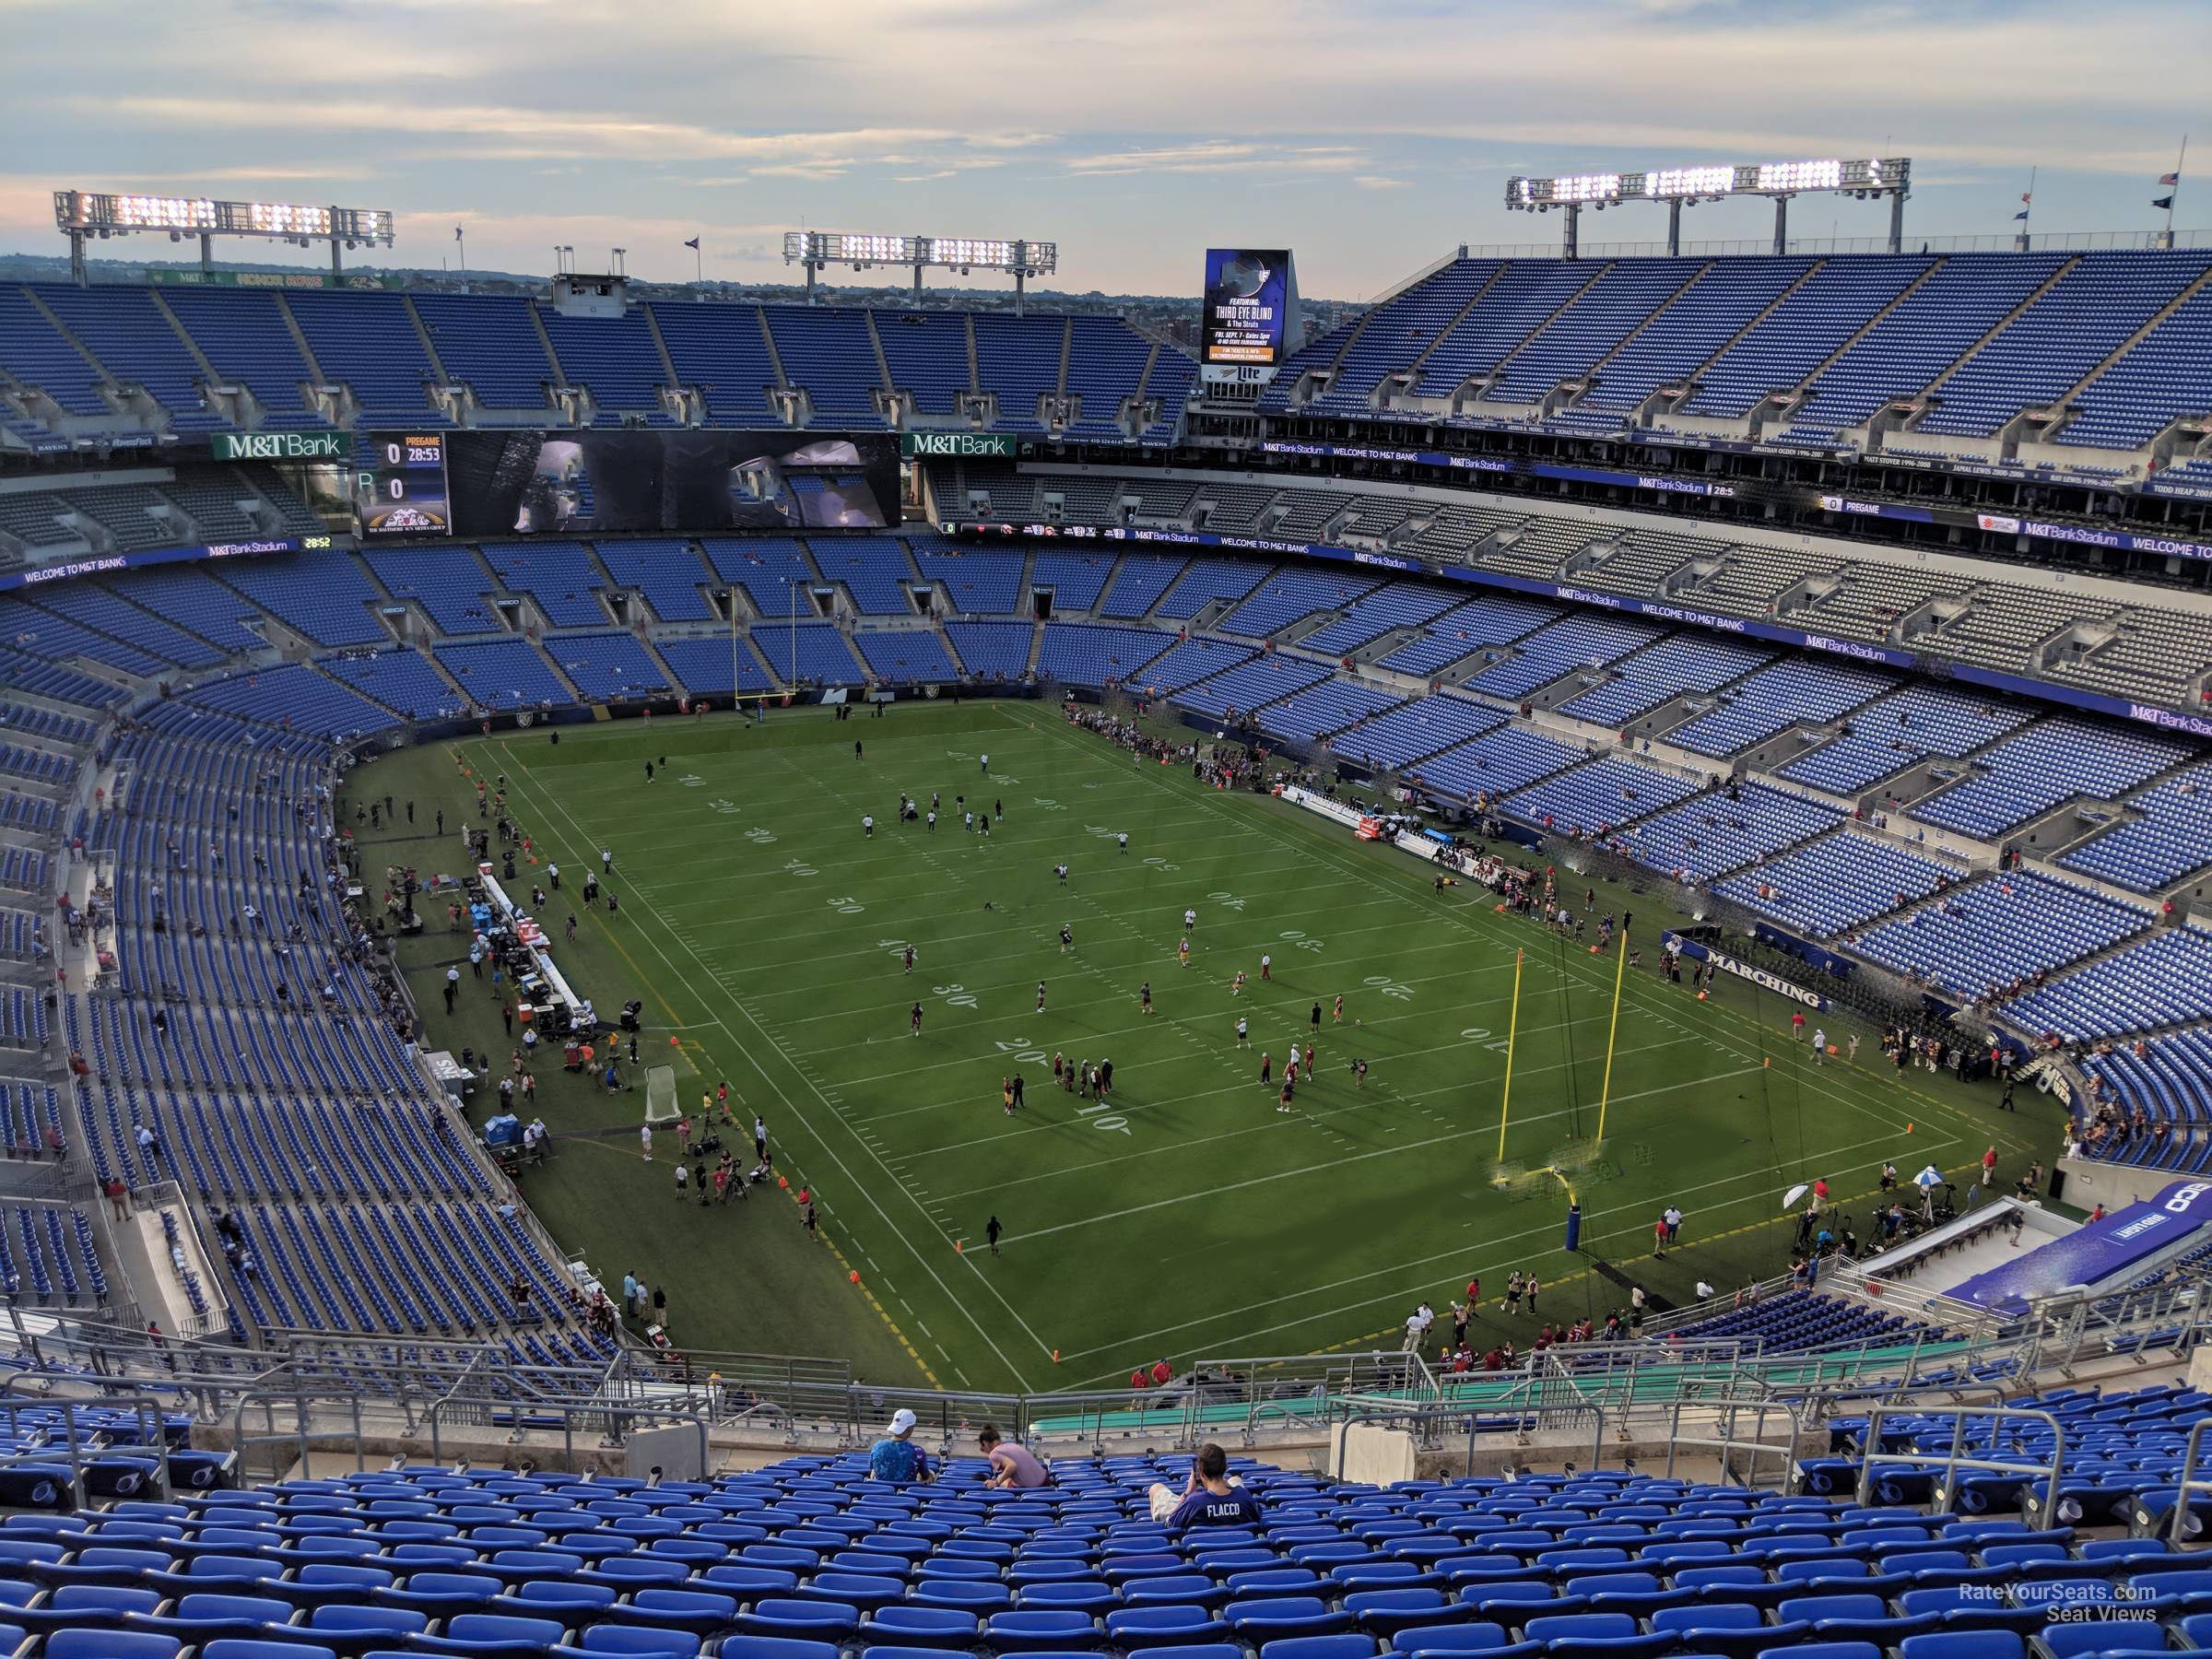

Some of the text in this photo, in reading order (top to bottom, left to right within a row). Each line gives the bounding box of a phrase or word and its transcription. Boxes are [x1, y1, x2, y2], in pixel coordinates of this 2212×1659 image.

[286, 276, 323, 287] ROWS
[1230, 298, 1260, 306] FEATURING:
[1217, 306, 1272, 320] THIRD EYE BLIND
[1242, 320, 1259, 328] Struts
[37, 443, 68, 452] RAVENS
[227, 433, 341, 458] M&T Bank
[406, 437, 441, 446] PREGAME
[912, 434, 1006, 455] M&T Bank
[1264, 443, 1324, 454] M&T Bank Stadium
[387, 443, 400, 465] 0
[408, 448, 441, 462] 28:53
[1333, 447, 1368, 457] WELCOME
[1369, 450, 1379, 458] TO
[1380, 452, 1395, 460] M&T
[1751, 445, 1777, 454] JONATHAN
[1797, 449, 1824, 458] 1996-2007
[1450, 456, 1505, 471] M&T Bank Stadium
[1878, 457, 1900, 465] STOVER
[1952, 464, 1972, 473] JAMAL
[1972, 466, 1992, 475] LEWIS
[1638, 477, 1703, 493] M&T Bank Stadium
[2064, 476, 2082, 484] LEWIS
[391, 478, 404, 499] 0
[2153, 485, 2173, 493] TODD
[2174, 487, 2194, 496] HEAP
[1846, 501, 1879, 514] PREGAME
[1135, 530, 1199, 544] M&T Bank Stadium
[2025, 522, 2053, 536] M&T
[2051, 525, 2077, 540] Bank
[2076, 529, 2118, 546] Stadium
[208, 542, 288, 557] M&T Bank Stadium
[305, 537, 331, 548] 28:52
[1221, 536, 1257, 548] WELCOME
[1259, 540, 1269, 549] TO
[1270, 542, 1287, 551] M&T
[2132, 537, 2194, 557] WELCOME
[1354, 552, 1406, 570] M&T Bank Stadium
[25, 567, 66, 582] WELCOME
[66, 565, 78, 575] TO
[78, 561, 97, 574] M&T
[1557, 587, 1620, 608] M&T Bank Stadium
[1641, 603, 1682, 618] WELCOME
[1685, 611, 1697, 621] TO
[1698, 612, 1716, 625] M&T
[1806, 634, 1886, 662] M&T Bank Stadium
[2129, 704, 2161, 723] M&T
[2159, 712, 2189, 730] Bank
[1706, 949, 1821, 1009] MARCHING
[1206, 1503, 1241, 1518] FLACCO
